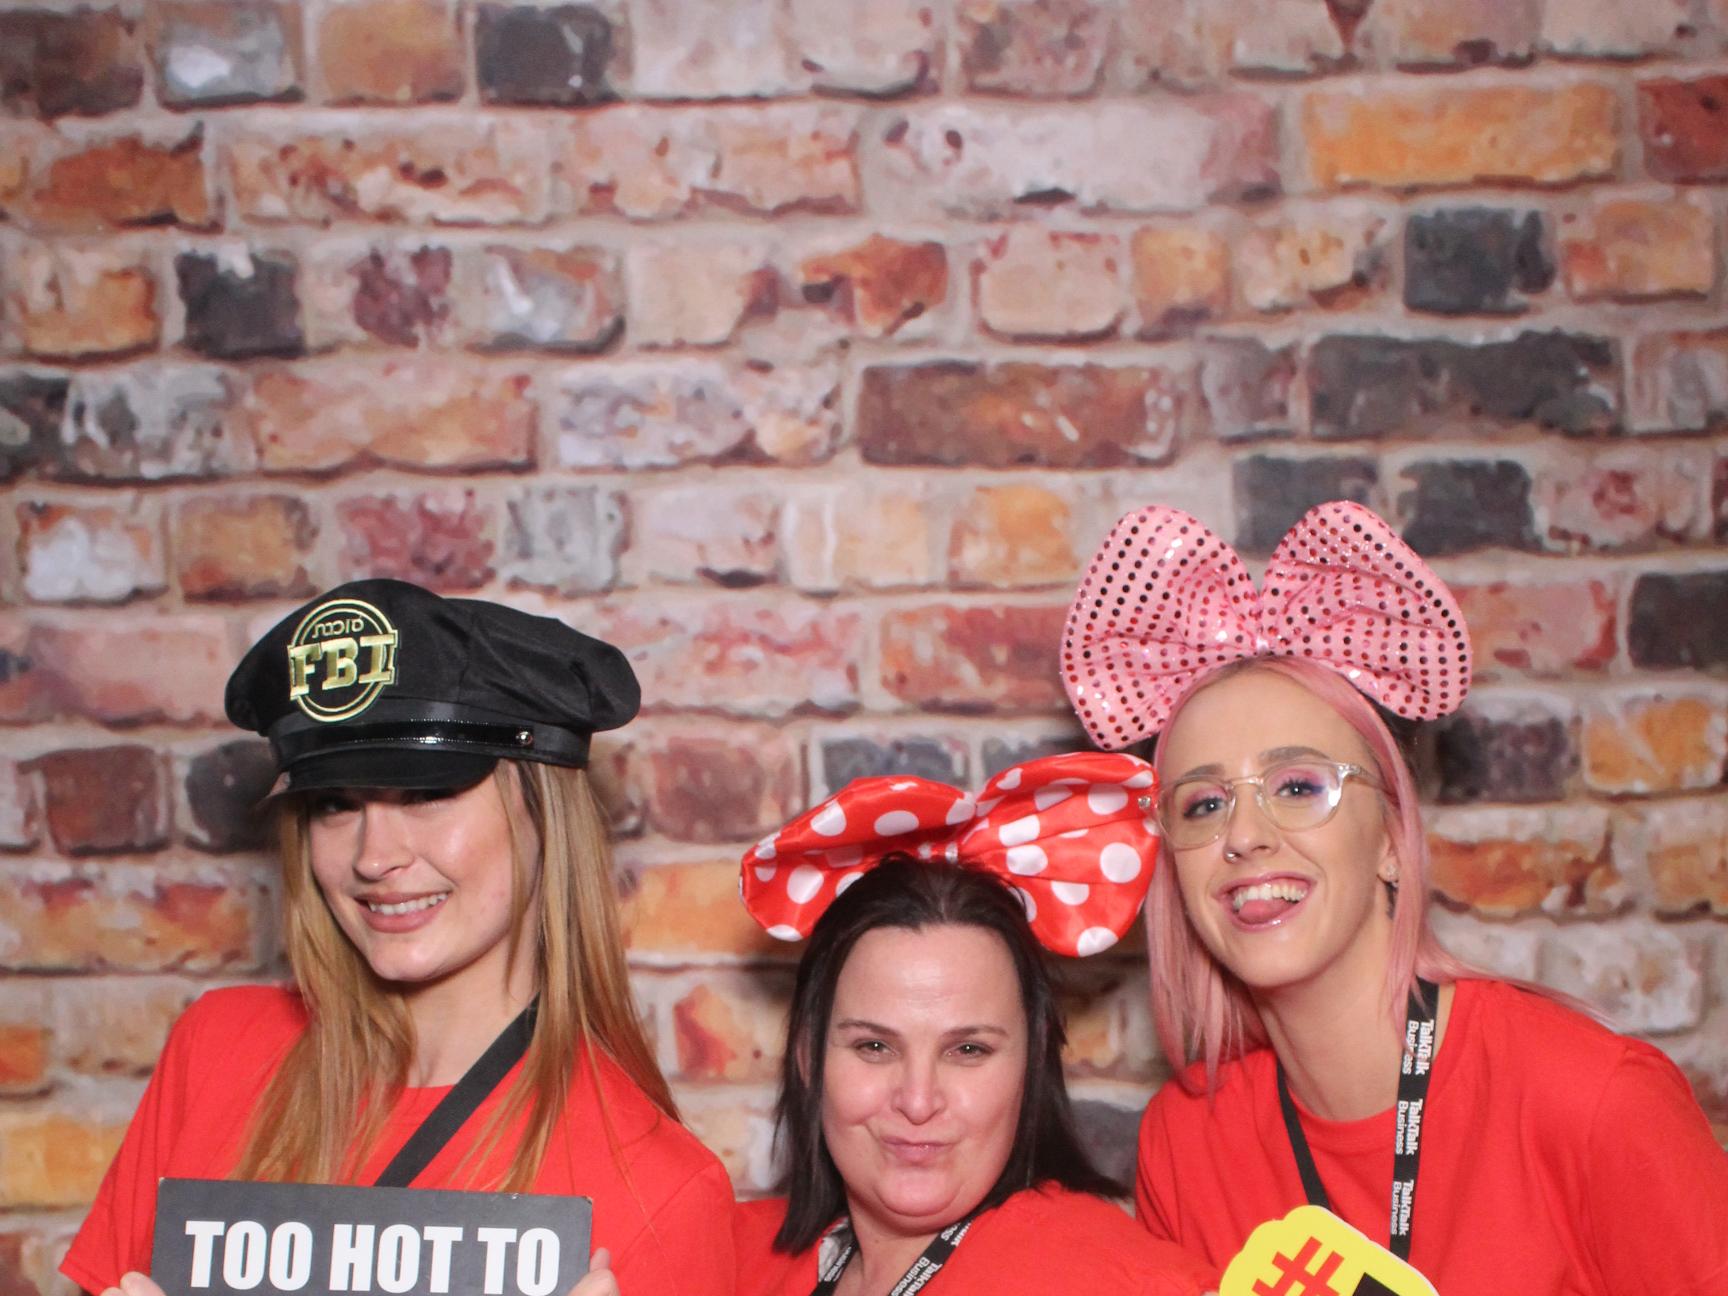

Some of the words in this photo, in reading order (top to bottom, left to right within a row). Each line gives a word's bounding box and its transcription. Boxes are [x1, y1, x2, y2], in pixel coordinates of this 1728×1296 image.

[288, 630, 397, 700] FBI
[1396, 1101, 1408, 1155] Business
[1406, 1099, 1423, 1156] TalkTalk
[1391, 1181, 1402, 1235] Business
[1400, 1179, 1414, 1236] TalkTalk
[185, 1219, 313, 1291] TOO
[328, 1223, 463, 1294] HOT
[477, 1226, 560, 1296] TO
